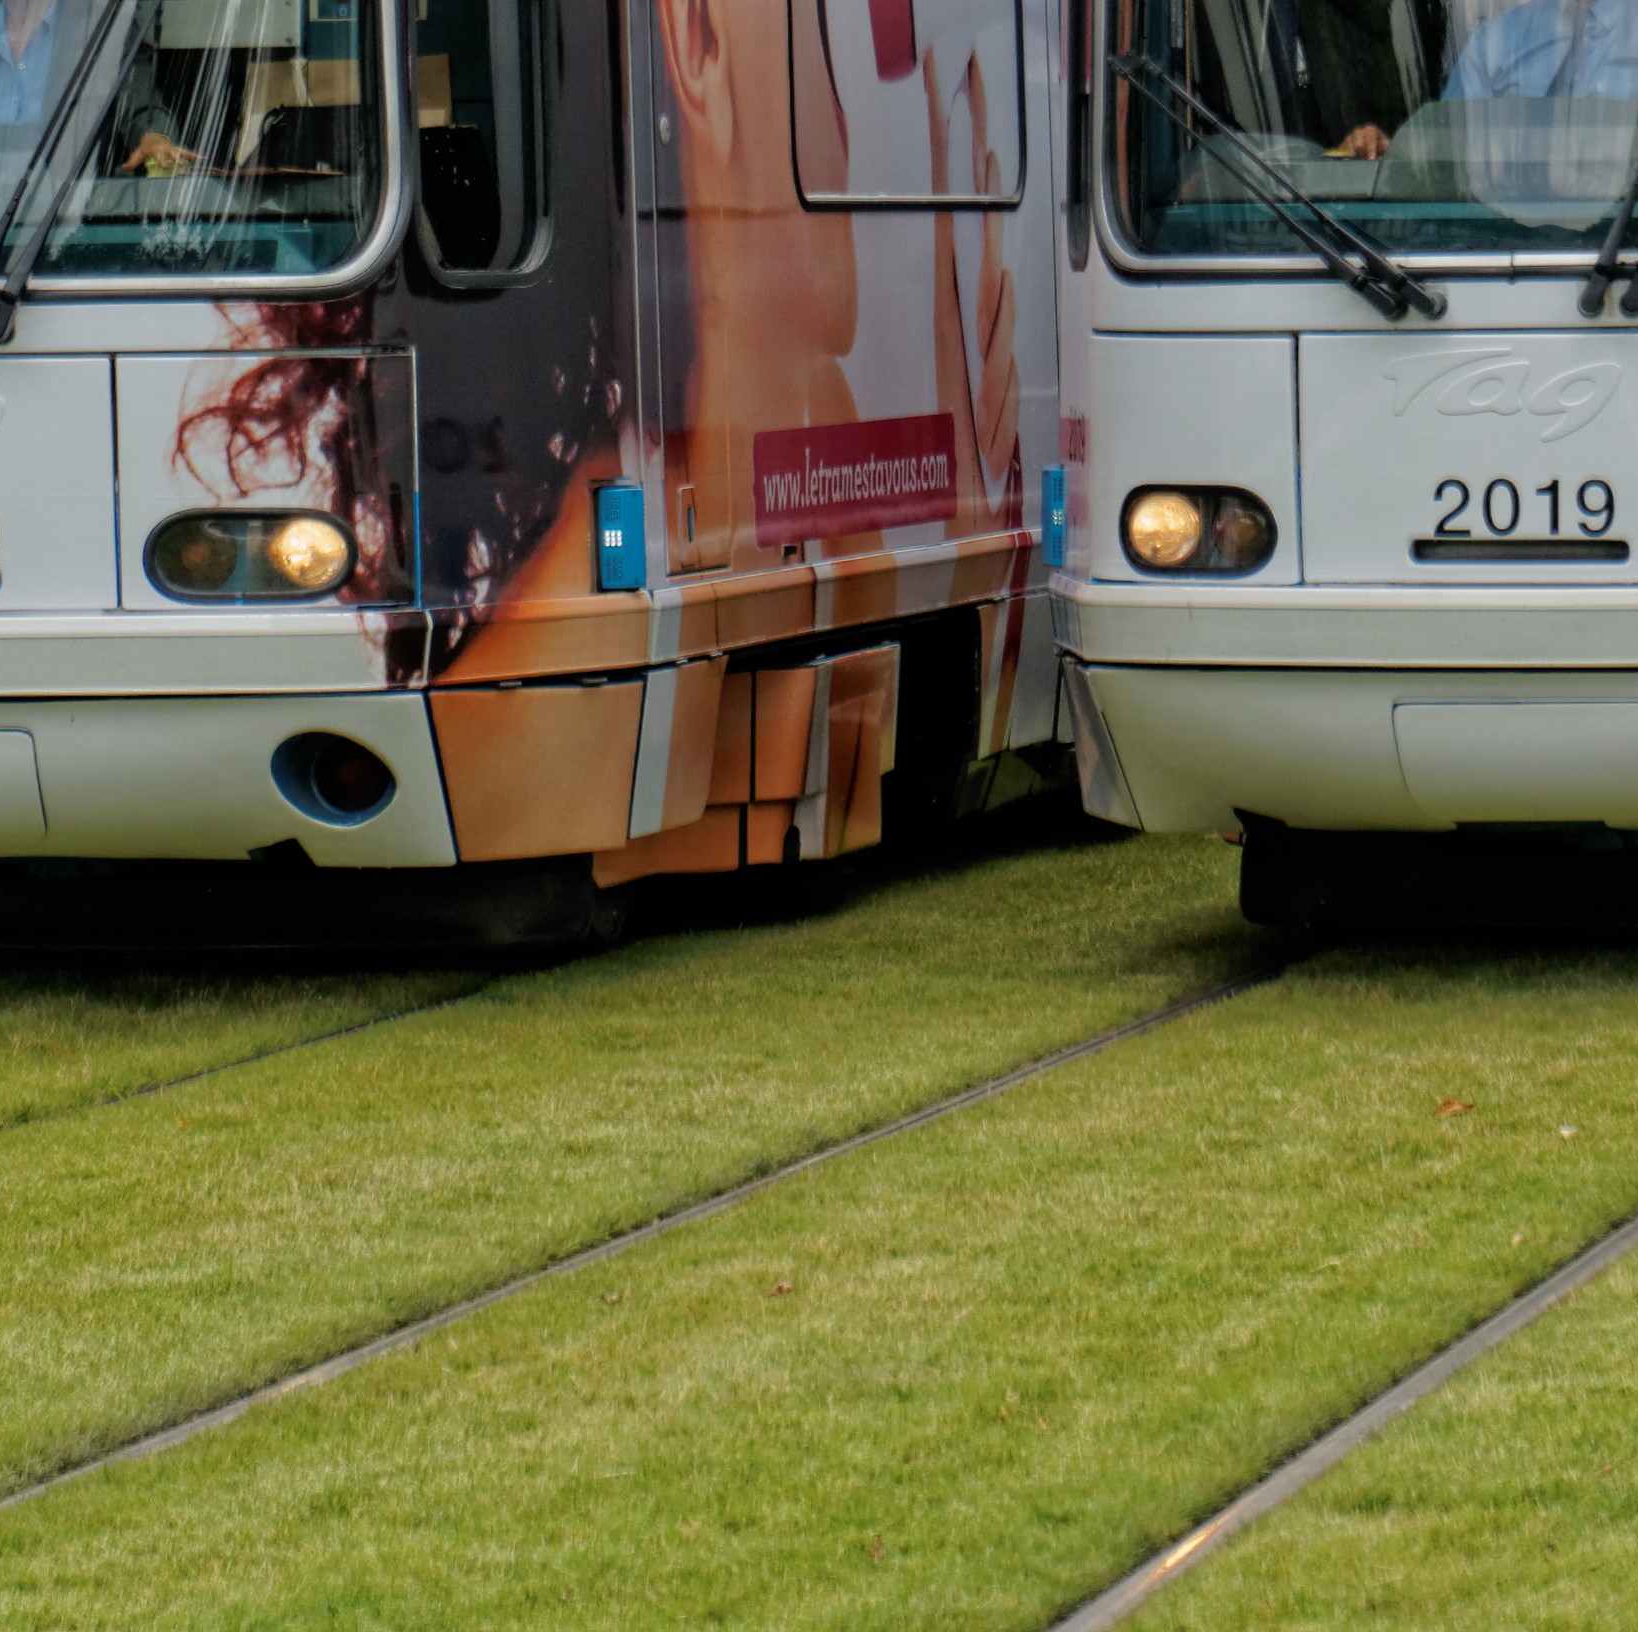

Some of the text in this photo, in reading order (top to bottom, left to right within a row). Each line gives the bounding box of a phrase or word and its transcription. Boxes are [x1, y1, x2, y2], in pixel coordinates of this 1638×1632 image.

[1381, 346, 1623, 444] Tag
[763, 446, 950, 514] www.letramestavous.com
[1433, 477, 1617, 538] 2019
